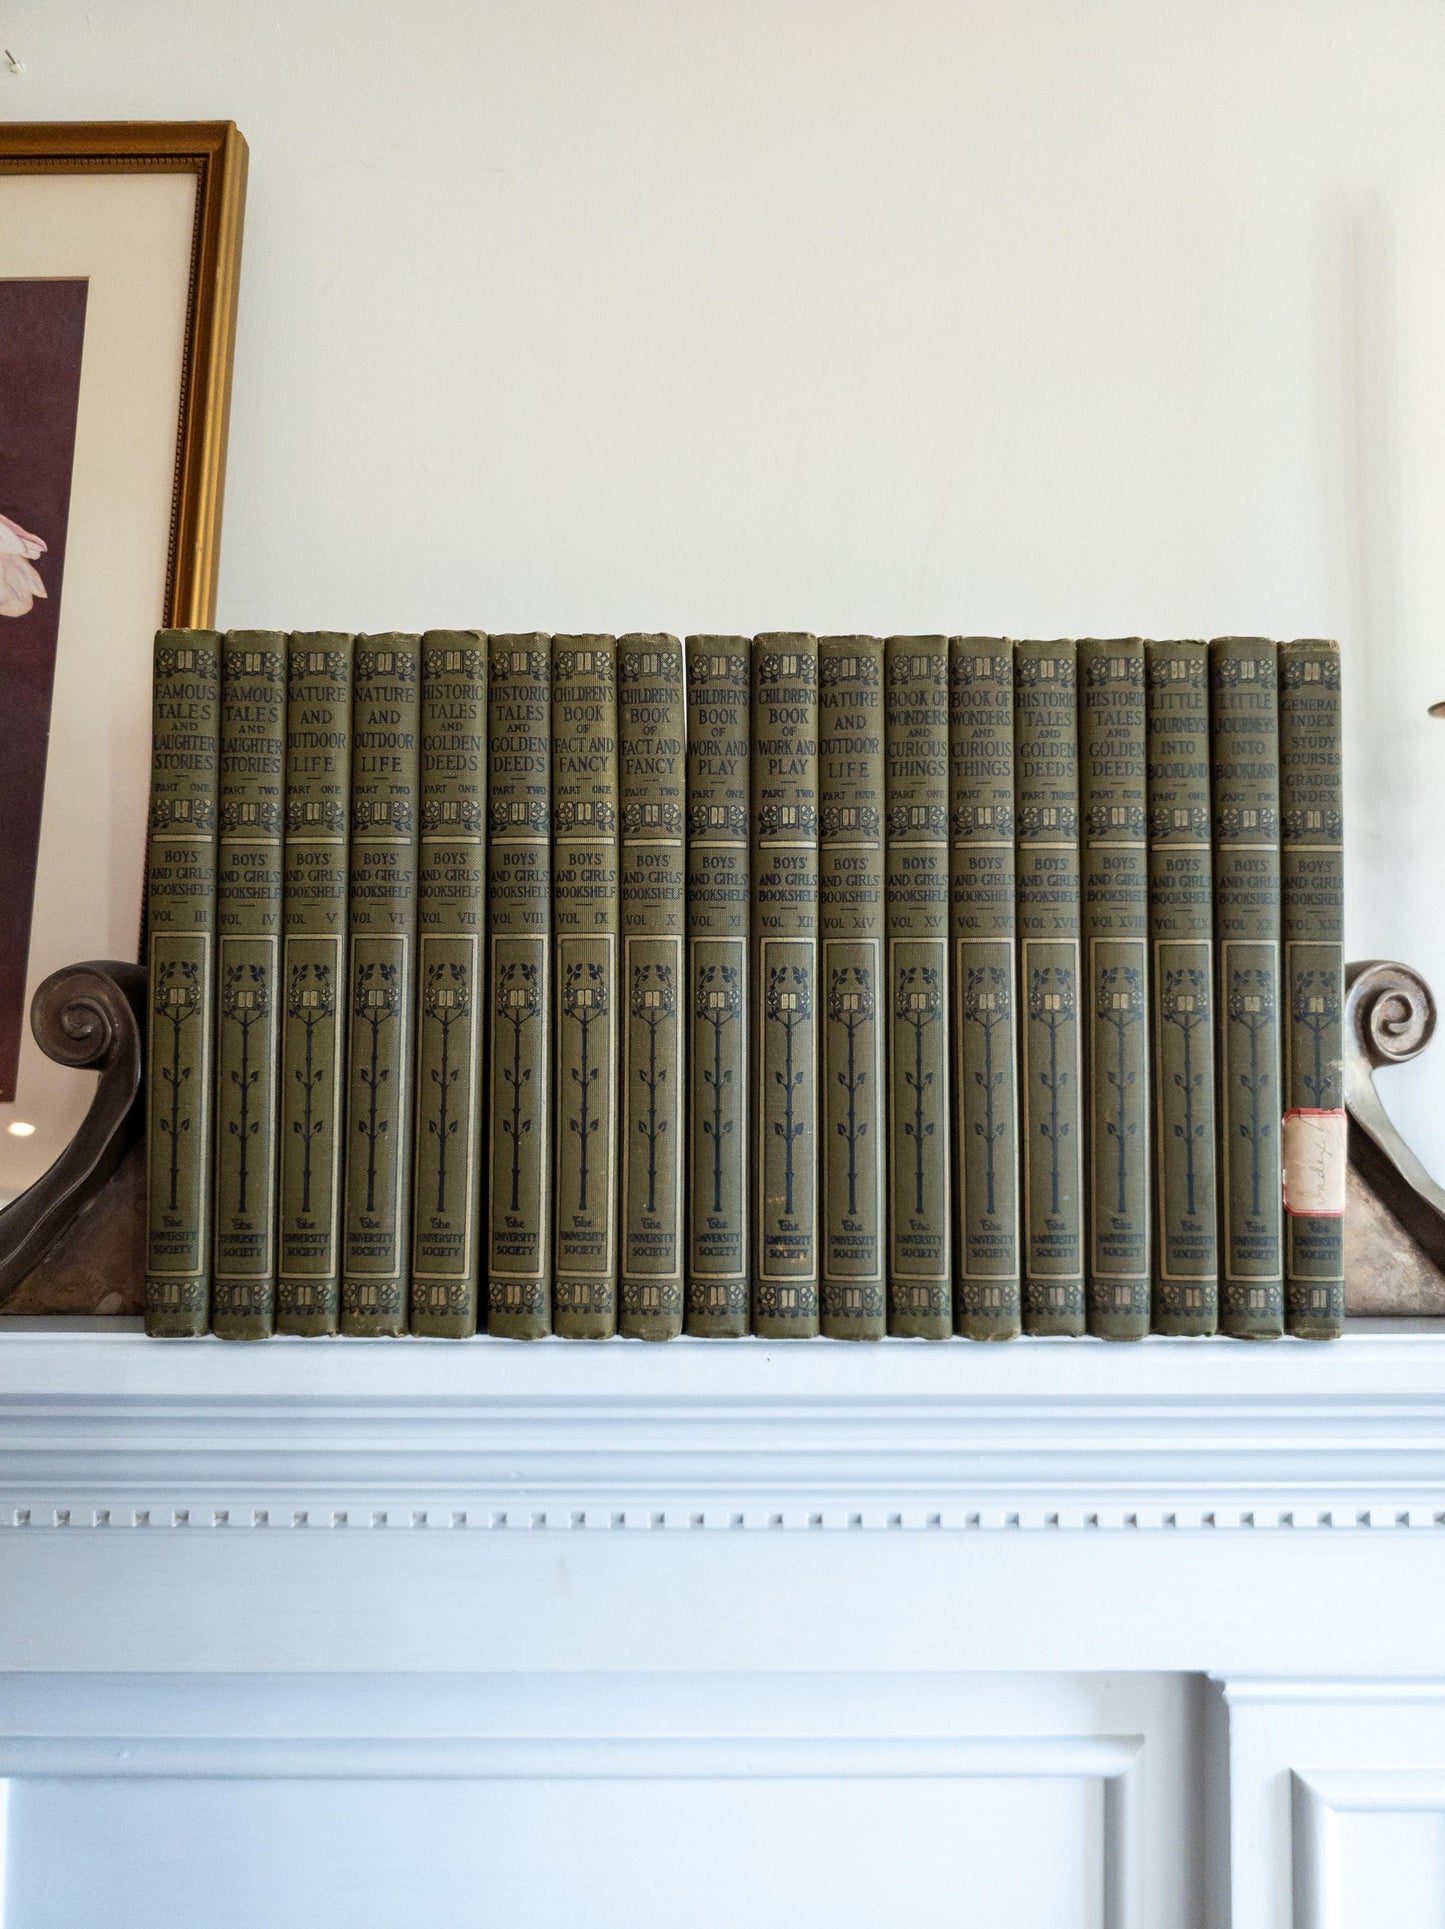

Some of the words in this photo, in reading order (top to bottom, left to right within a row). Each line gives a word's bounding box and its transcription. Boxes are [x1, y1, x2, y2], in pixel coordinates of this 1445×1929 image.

[153, 684, 217, 700] FAMOUS
[222, 687, 284, 704] FAMOUS
[354, 687, 415, 703] NATURE
[423, 684, 484, 701] HISTORIC
[490, 685, 550, 701] HISTORIC
[554, 686, 614, 702] CHILDREN'S
[620, 688, 680, 705] CHILDREN'S
[687, 690, 748, 706] CHILDREN'S
[758, 688, 817, 705] CHILDREN'S
[818, 691, 879, 708] NATURE
[887, 691, 928, 707] BOOK
[931, 691, 948, 706] OF
[951, 691, 992, 707] BOOK
[995, 691, 1012, 706] OF
[1150, 694, 1202, 710] LITTLE
[157, 704, 212, 720] TALES
[225, 707, 278, 723] TALES
[300, 710, 333, 724] AND
[367, 710, 401, 724] AND
[428, 704, 478, 720] TALES
[495, 706, 545, 721] TALES
[562, 706, 605, 722] BOOK
[630, 708, 672, 724] BOOK
[698, 709, 738, 725] BOOK
[768, 708, 809, 724] BOOK
[886, 710, 948, 726] WONDERS
[950, 710, 1012, 726] WONDERS
[1024, 711, 1073, 727] TALES
[1093, 711, 1143, 726] TALES
[171, 722, 199, 731] AND
[439, 722, 463, 732] AND
[506, 723, 530, 732] AND
[833, 716, 867, 730] AND
[1290, 715, 1335, 727] INDEX
[237, 724, 266, 734] AND
[576, 724, 591, 734] OF
[642, 726, 658, 735] OF
[710, 727, 726, 737] OF
[782, 726, 797, 736] OF
[906, 728, 932, 738] AND
[971, 728, 995, 738] AND
[1037, 730, 1062, 739] AND
[1106, 729, 1131, 738] AND
[154, 735, 216, 751] LAUGHTER
[354, 732, 414, 749] OUTDOOR
[423, 735, 482, 751] GOLDEN
[490, 736, 548, 752] GOLDEN
[554, 738, 585, 752] FACT
[588, 738, 615, 753] AND
[621, 740, 652, 755] FACT
[655, 740, 682, 755] AND
[757, 740, 793, 756] WORK
[795, 740, 818, 756] AND
[818, 738, 880, 754] OUTDOOR
[1291, 736, 1336, 748] STUDY
[687, 741, 722, 756] WORK
[725, 741, 748, 756] AND
[887, 741, 948, 757] CURIOUS
[952, 742, 1012, 758] CURIOUS
[1020, 742, 1077, 758] GOLDEN
[154, 754, 214, 770] STORIES
[222, 757, 281, 774] STORIES
[293, 757, 335, 772] LIFE
[361, 756, 403, 772] LIFE
[424, 756, 478, 770] DEEDS
[493, 756, 546, 772] DEEDS
[558, 757, 610, 773] FANCY
[625, 759, 676, 774] FANCY
[698, 760, 738, 776] PLAY
[768, 760, 809, 775] PLAY
[889, 761, 946, 776] THINGS
[953, 761, 1011, 777] THINGS
[1092, 761, 1145, 777] DEEDS
[828, 762, 870, 778] LIFE
[1023, 762, 1075, 778] DEEDS
[1285, 774, 1341, 786] GRADED
[224, 786, 246, 795] PART
[257, 786, 280, 796] TWO
[288, 786, 312, 794] PART
[320, 786, 342, 794] ONE
[355, 786, 379, 794] PART
[388, 786, 411, 795] TWO
[424, 784, 448, 793] PART
[458, 784, 479, 793] ONE
[492, 786, 516, 795] PART
[557, 786, 581, 794] PART
[591, 786, 612, 794] ONE
[624, 788, 648, 796] PART
[659, 788, 680, 796] TWO
[691, 790, 715, 799] PART
[725, 790, 745, 798] ONE
[761, 790, 786, 798] PART
[794, 789, 814, 798] TWO
[890, 790, 915, 798] PART
[926, 790, 946, 798] ONE
[1291, 790, 1336, 802] INDEX
[555, 870, 577, 882] AND
[622, 872, 644, 884] AND
[555, 886, 617, 899] BOOKSHELF
[622, 888, 683, 900] BOOKSHELF
[152, 911, 174, 922] VOL
[193, 911, 208, 922] III
[286, 913, 307, 924] VOL
[325, 913, 338, 924] V
[421, 913, 443, 924] VOL
[457, 913, 476, 924] VII
[492, 913, 513, 924] VOL
[522, 913, 544, 924] VIII
[558, 913, 580, 924] VOL
[594, 913, 610, 924] IX
[625, 914, 647, 926] VOL
[666, 914, 676, 926] X
[761, 916, 784, 927] VOL
[796, 916, 814, 927] XII
[822, 918, 845, 928] VOL
[852, 918, 876, 928] XIV
[890, 916, 913, 928] VOL
[924, 916, 943, 928] XV
[505, 1216, 524, 1228] The
[778, 1219, 800, 1232] The
